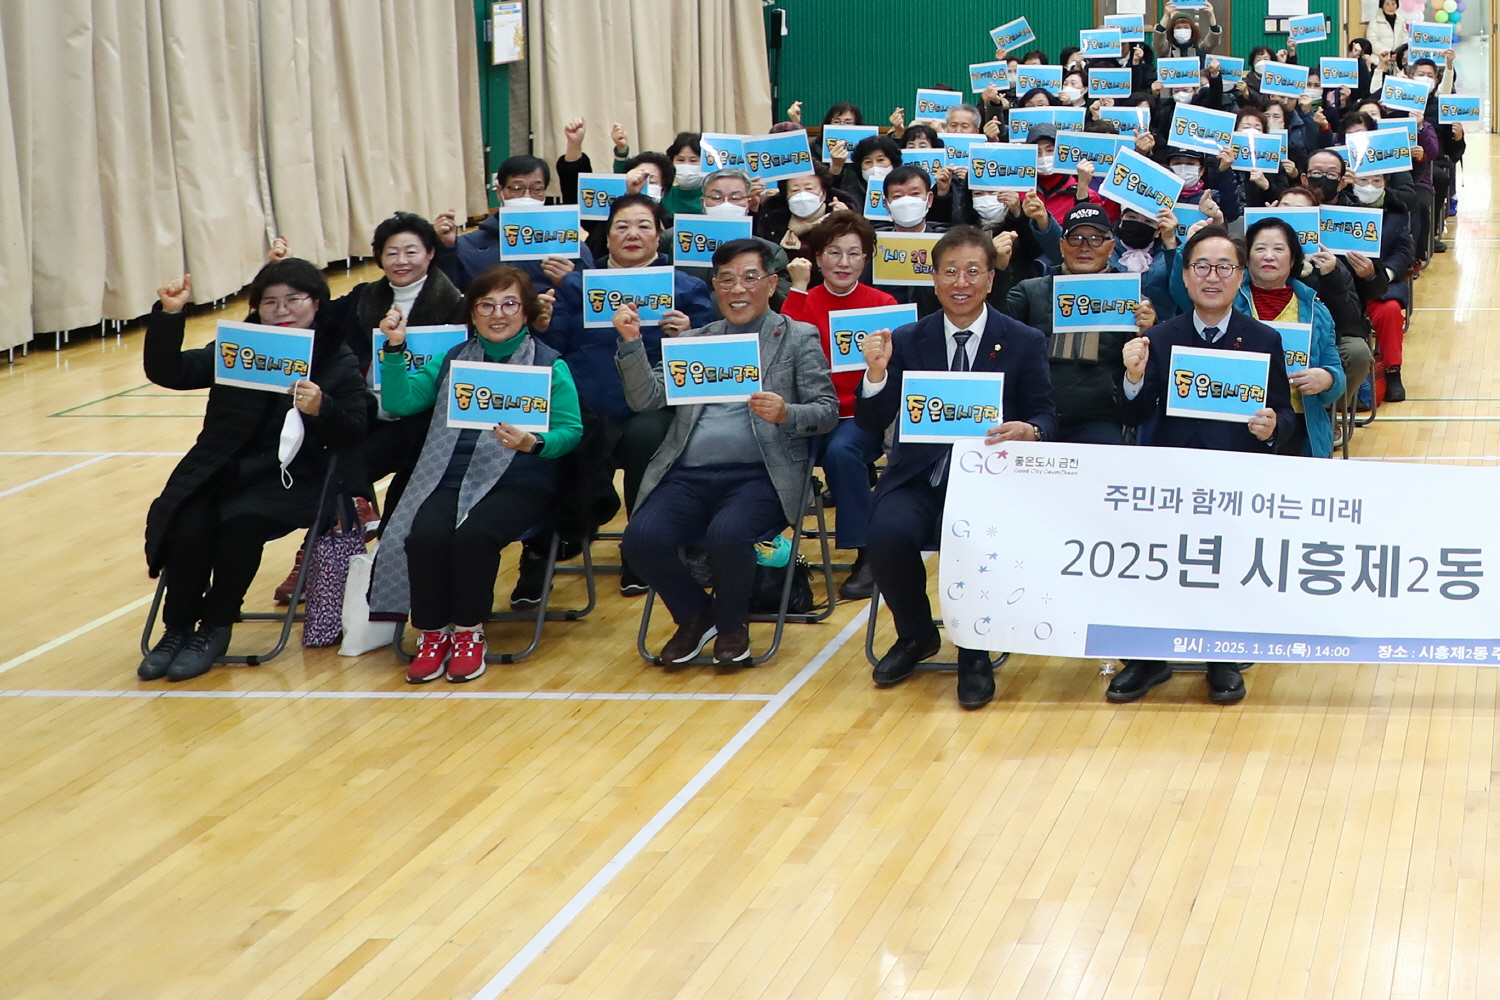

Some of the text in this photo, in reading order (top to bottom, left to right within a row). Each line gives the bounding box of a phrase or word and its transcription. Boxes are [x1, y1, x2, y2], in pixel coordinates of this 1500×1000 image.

[1015, 456, 1079, 469] 좋은도시 금천
[1104, 485, 1362, 524] 주민과 함께 여는 미래
[1060, 533, 1222, 589] 2025년
[1240, 537, 1484, 600] 시흥제2동
[1173, 637, 1204, 653] 일시
[1213, 640, 1248, 654] 2025.
[1315, 645, 1350, 657] 14:00
[1378, 645, 1408, 659] 장소
[1419, 646, 1488, 660] 시흥제2동
